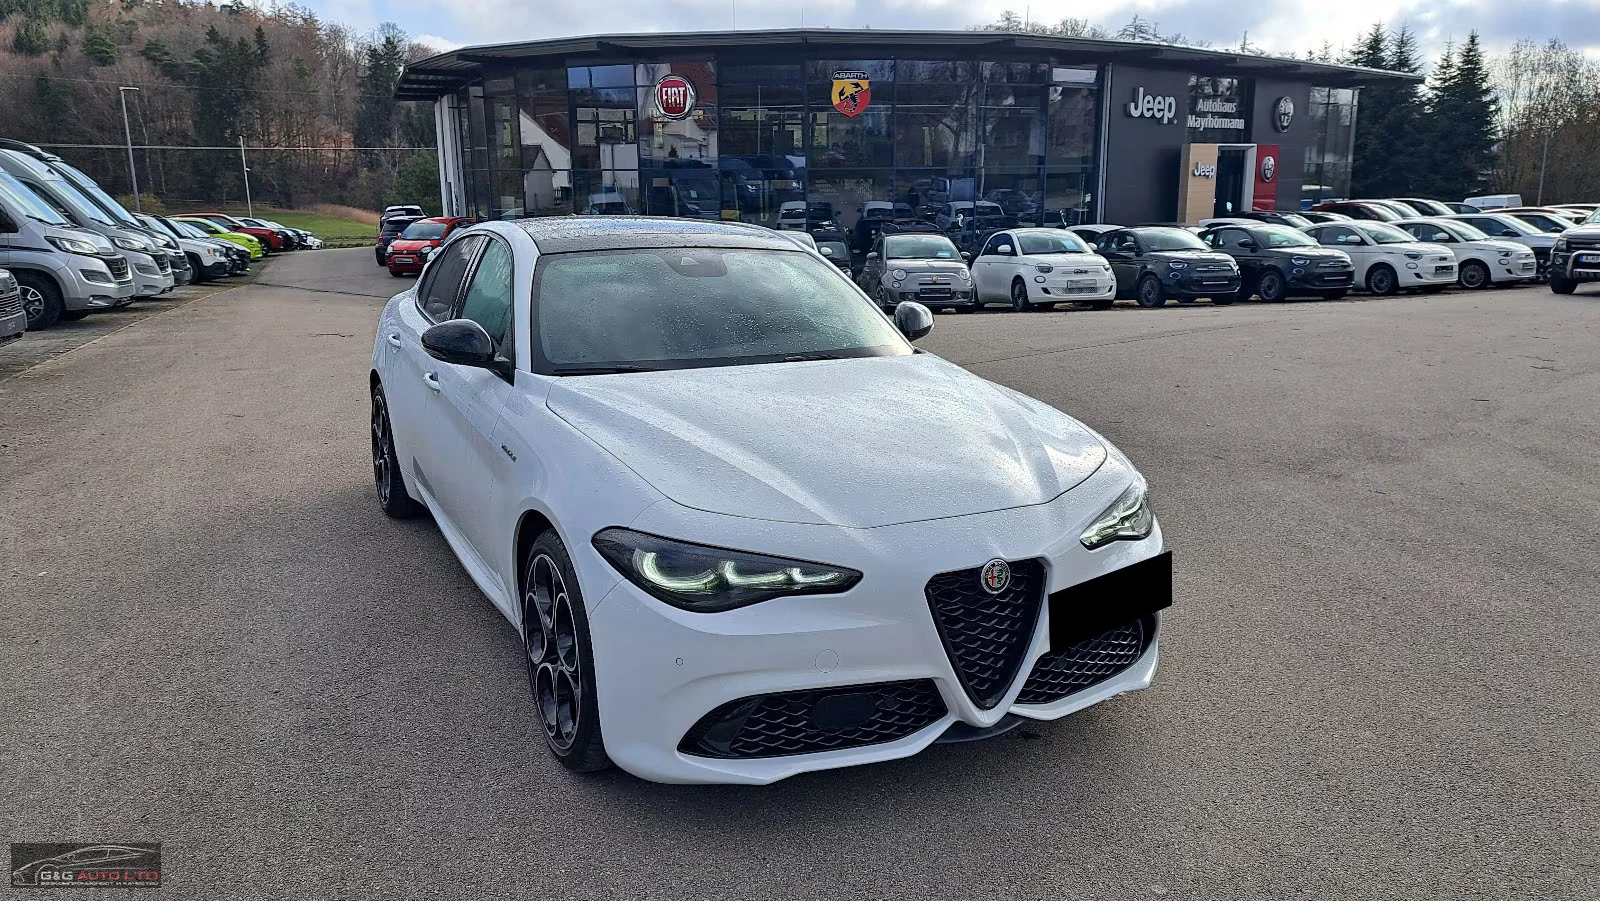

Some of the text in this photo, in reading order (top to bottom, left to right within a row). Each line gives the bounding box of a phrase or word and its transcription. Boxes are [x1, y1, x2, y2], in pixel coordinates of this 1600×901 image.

[834, 72, 868, 80] ABARTH
[662, 87, 686, 107] FIAT
[1130, 86, 1176, 124] Jeep
[1197, 98, 1236, 113] Autohaus
[1187, 114, 1245, 131] Mayrhörmann
[1194, 162, 1215, 179] Jeep
